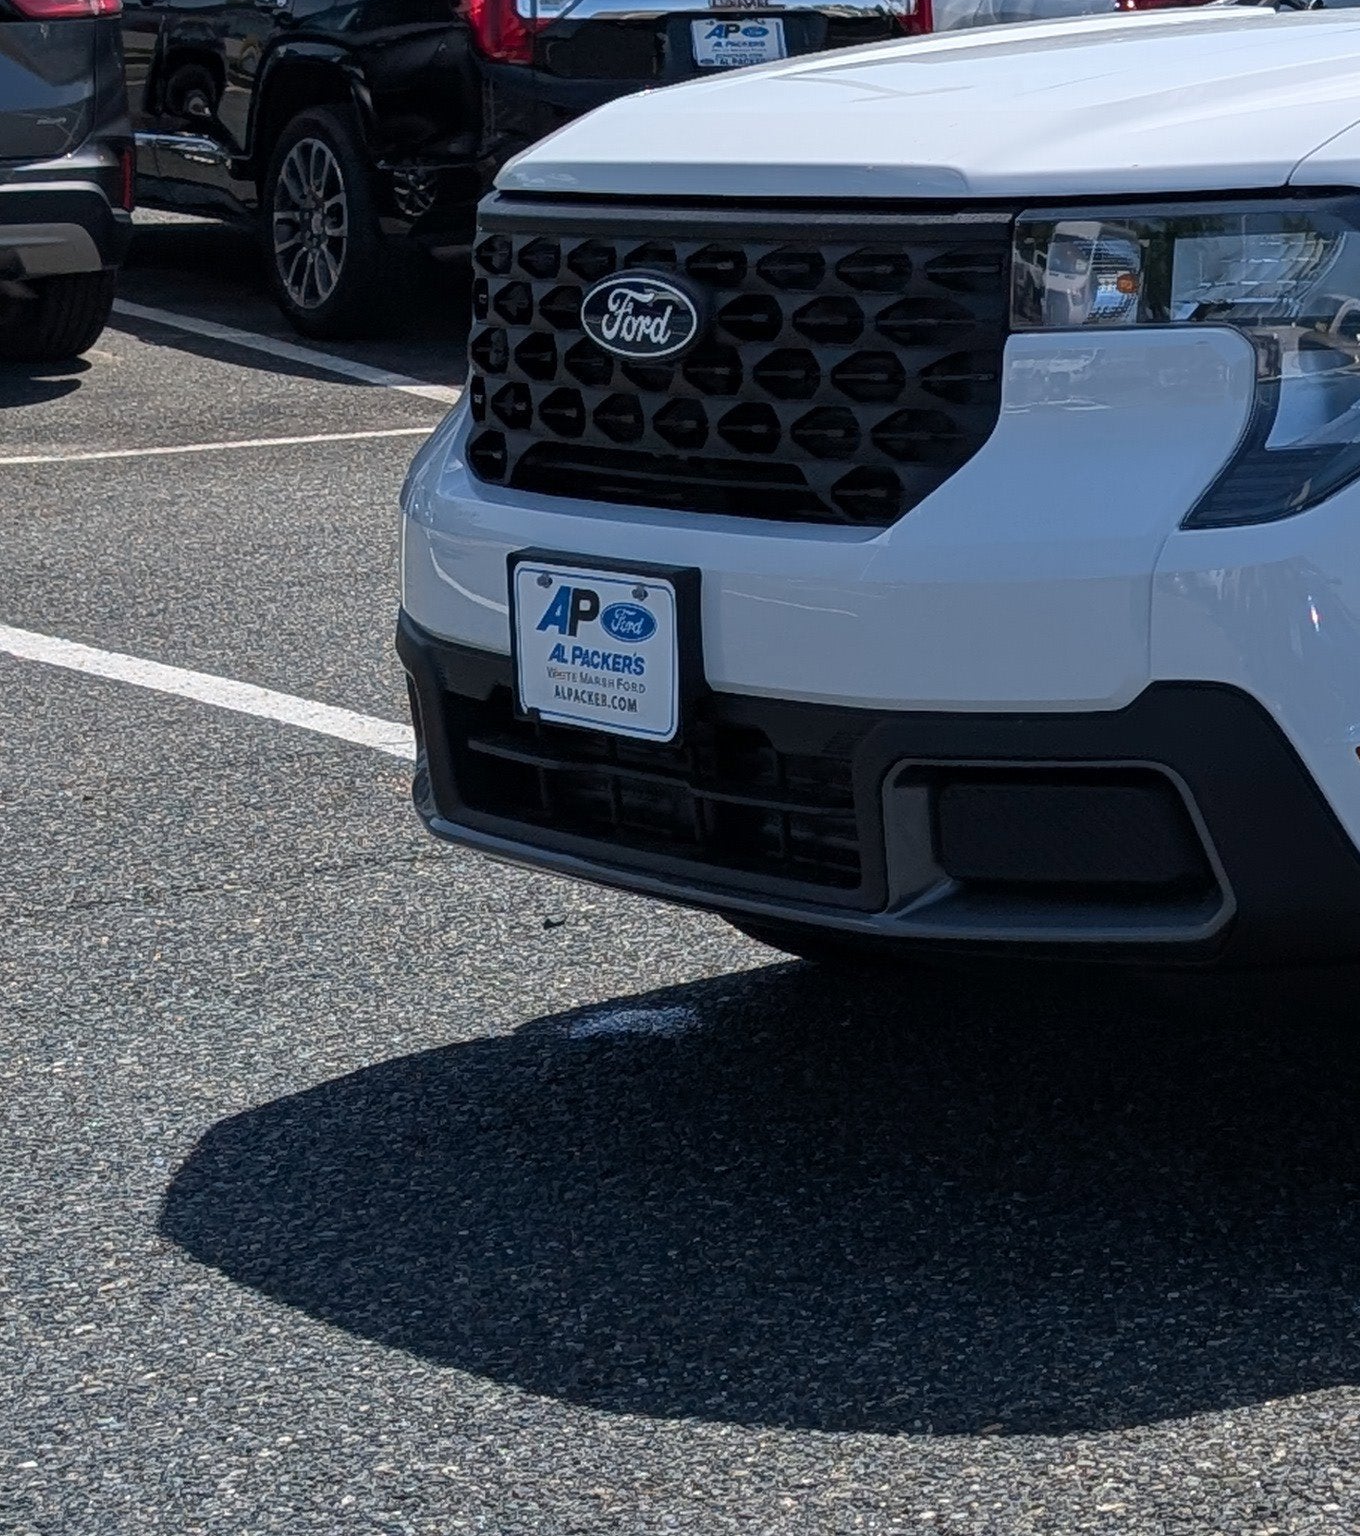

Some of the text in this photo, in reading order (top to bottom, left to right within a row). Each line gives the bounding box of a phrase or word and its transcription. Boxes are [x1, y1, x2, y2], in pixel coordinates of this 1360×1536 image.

[704, 24, 741, 39] AP
[601, 288, 673, 345] Ford
[536, 585, 644, 636] AP Ford
[548, 642, 646, 676] AL PACKER'S
